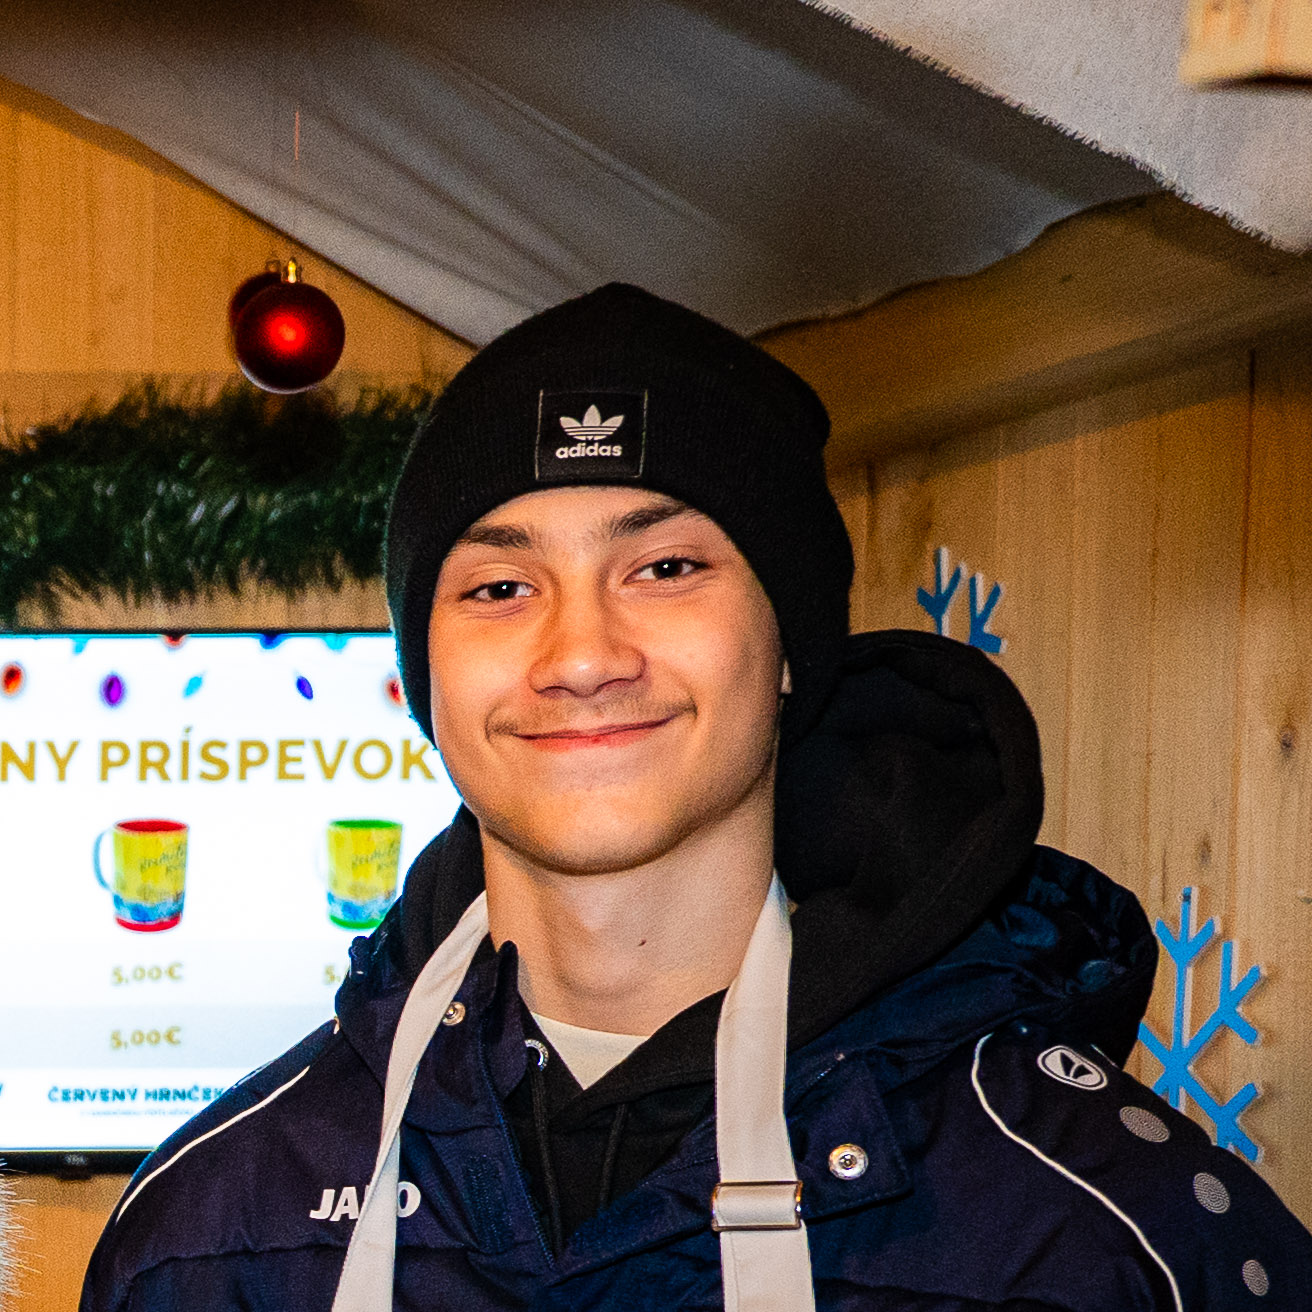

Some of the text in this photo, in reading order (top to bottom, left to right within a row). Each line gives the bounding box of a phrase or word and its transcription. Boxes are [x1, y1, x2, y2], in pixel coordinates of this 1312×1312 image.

[555, 443, 622, 459] adidas
[98, 726, 437, 782] PRÍSPEVOK
[47, 1085, 139, 1102] ČERVENÝ
[309, 1181, 422, 1222] JAO
